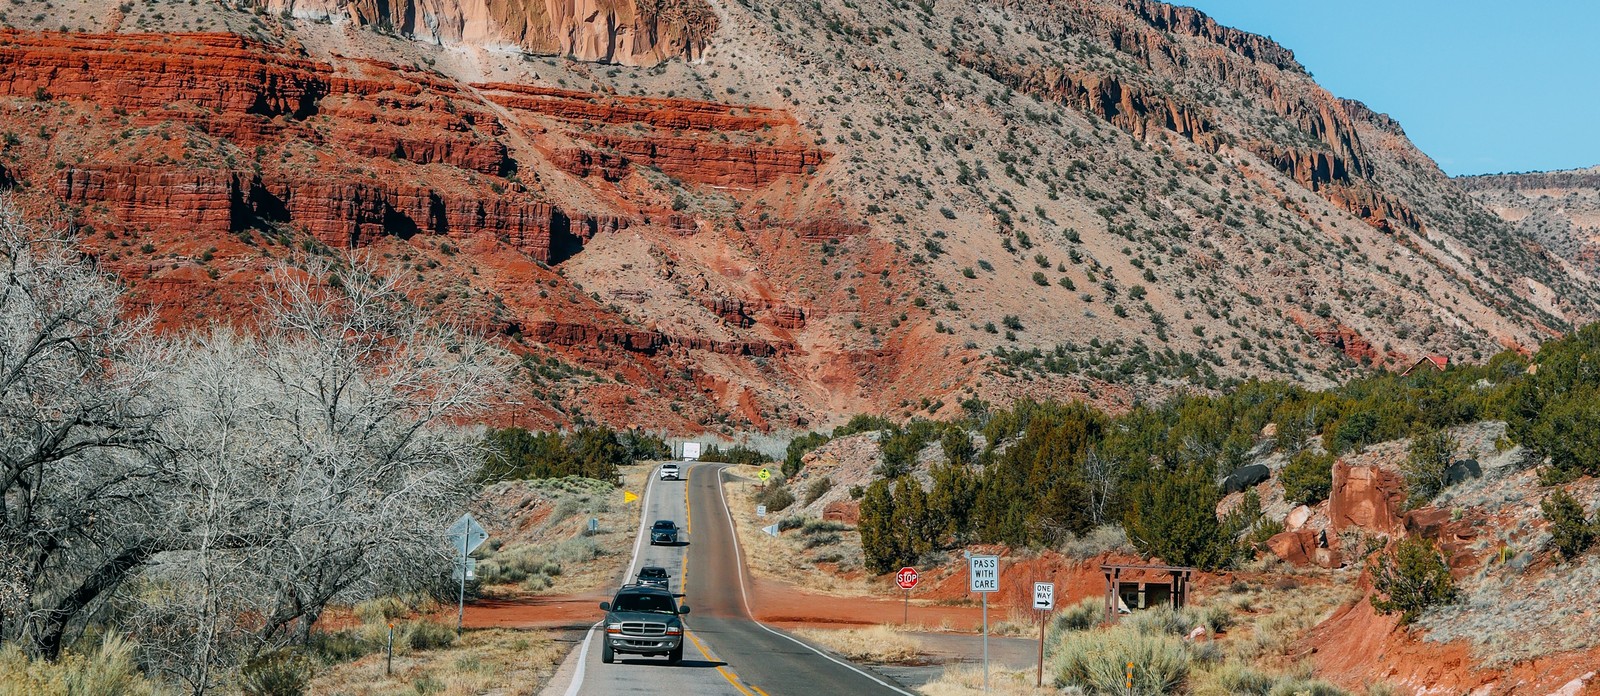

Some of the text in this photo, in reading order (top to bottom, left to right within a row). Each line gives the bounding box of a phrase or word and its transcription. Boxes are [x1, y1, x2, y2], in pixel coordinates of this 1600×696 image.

[974, 559, 995, 568] PASS
[975, 570, 993, 578] WITH
[898, 574, 917, 583] STOP
[974, 580, 995, 588] CARE
